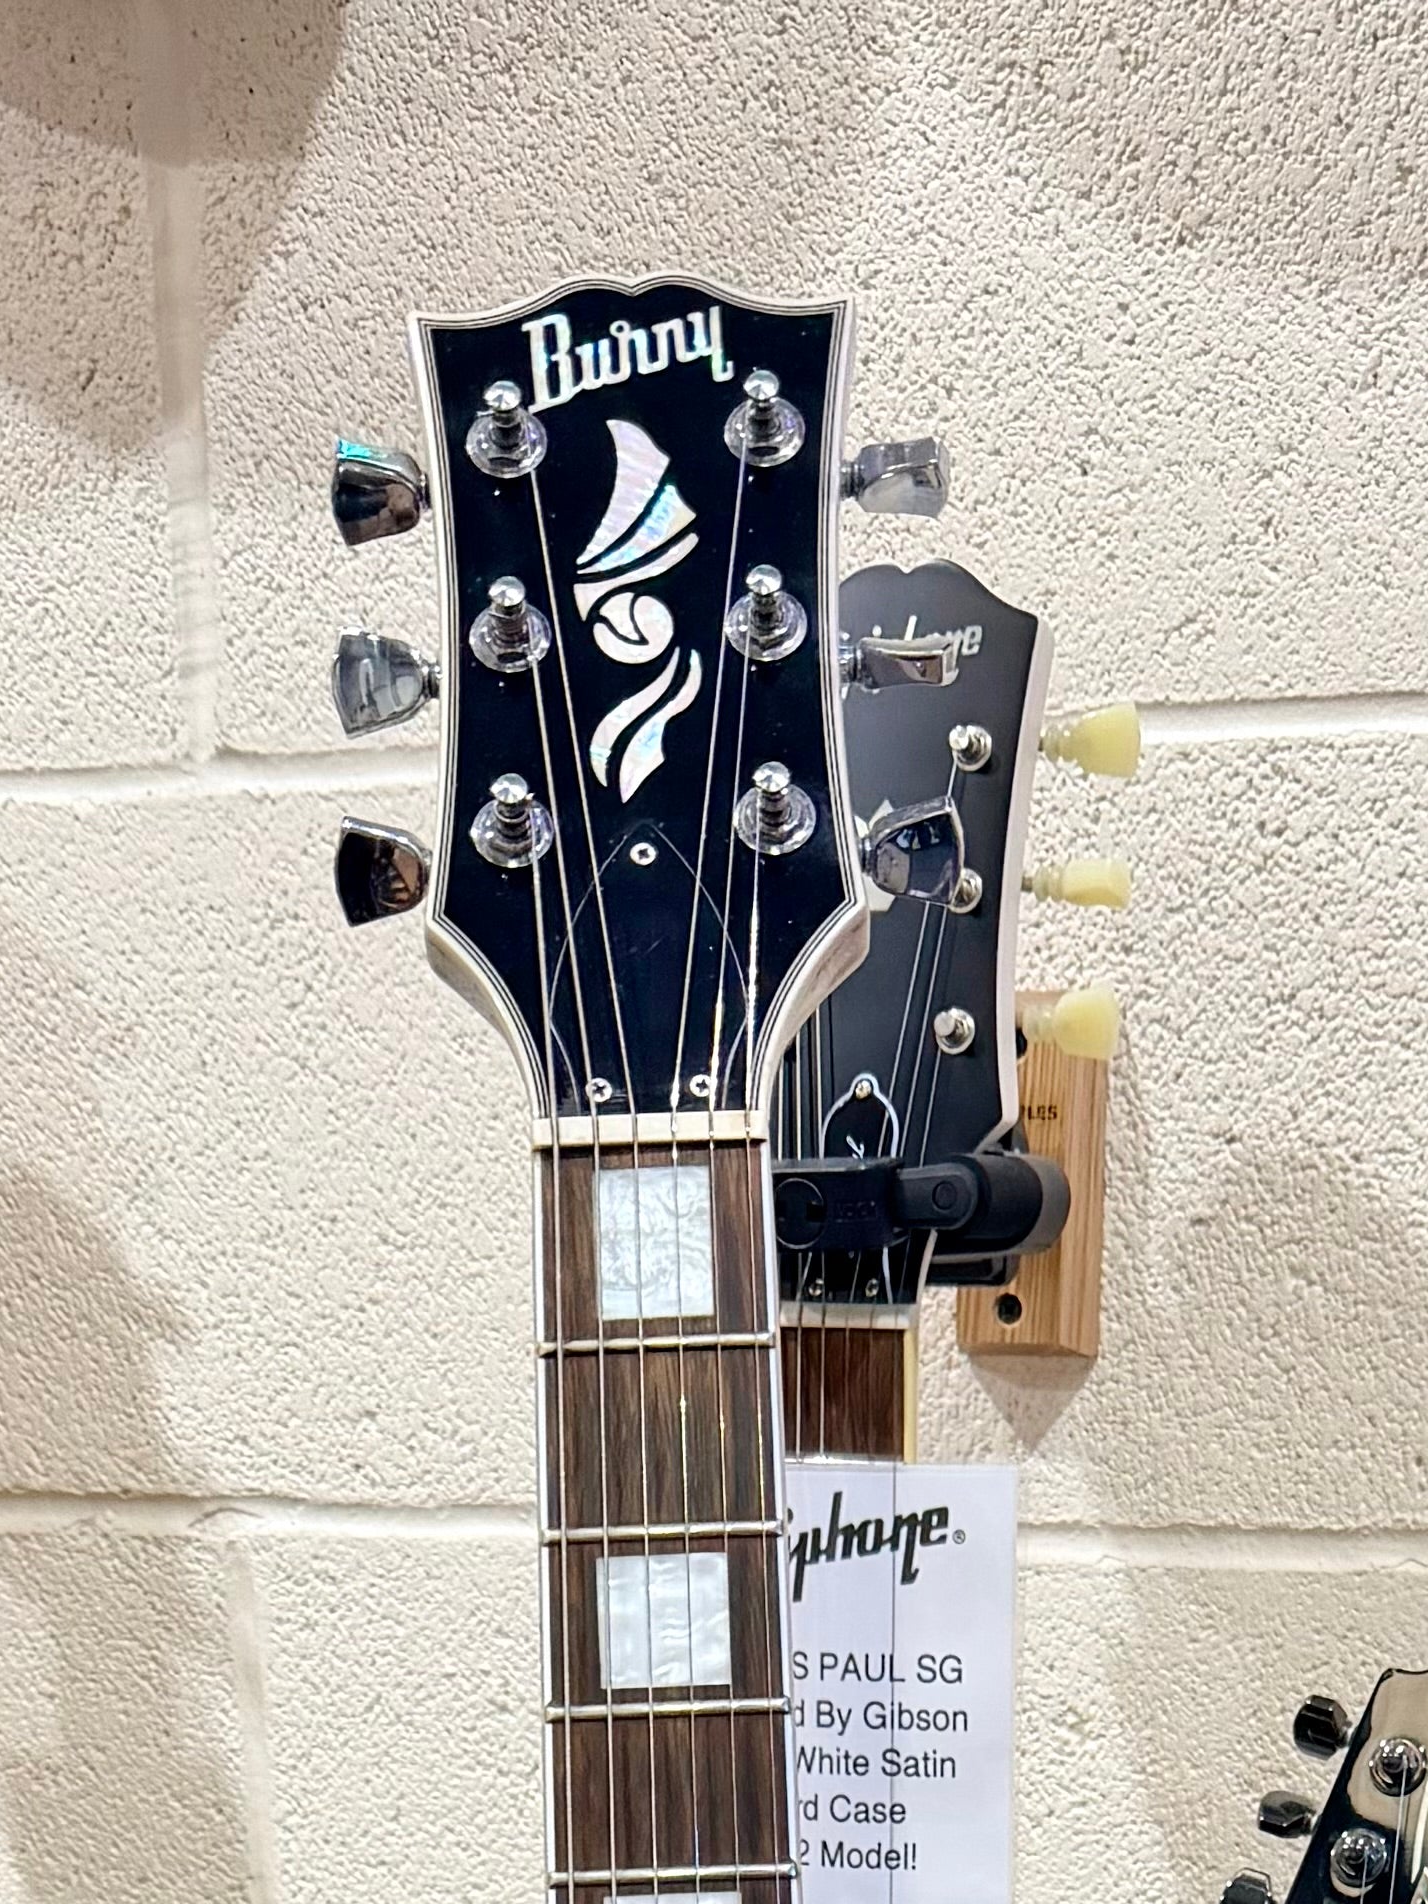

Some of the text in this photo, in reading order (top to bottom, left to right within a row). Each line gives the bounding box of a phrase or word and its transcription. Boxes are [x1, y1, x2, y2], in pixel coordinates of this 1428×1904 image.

[521, 305, 735, 415] Burny
[819, 1651, 907, 1684] PAUL
[916, 1654, 963, 1685] SG
[816, 1701, 853, 1735] By
[862, 1701, 969, 1734] Gibson
[879, 1748, 957, 1779] Satin
[829, 1795, 907, 1824] Case
[820, 1841, 919, 1871] Model!
